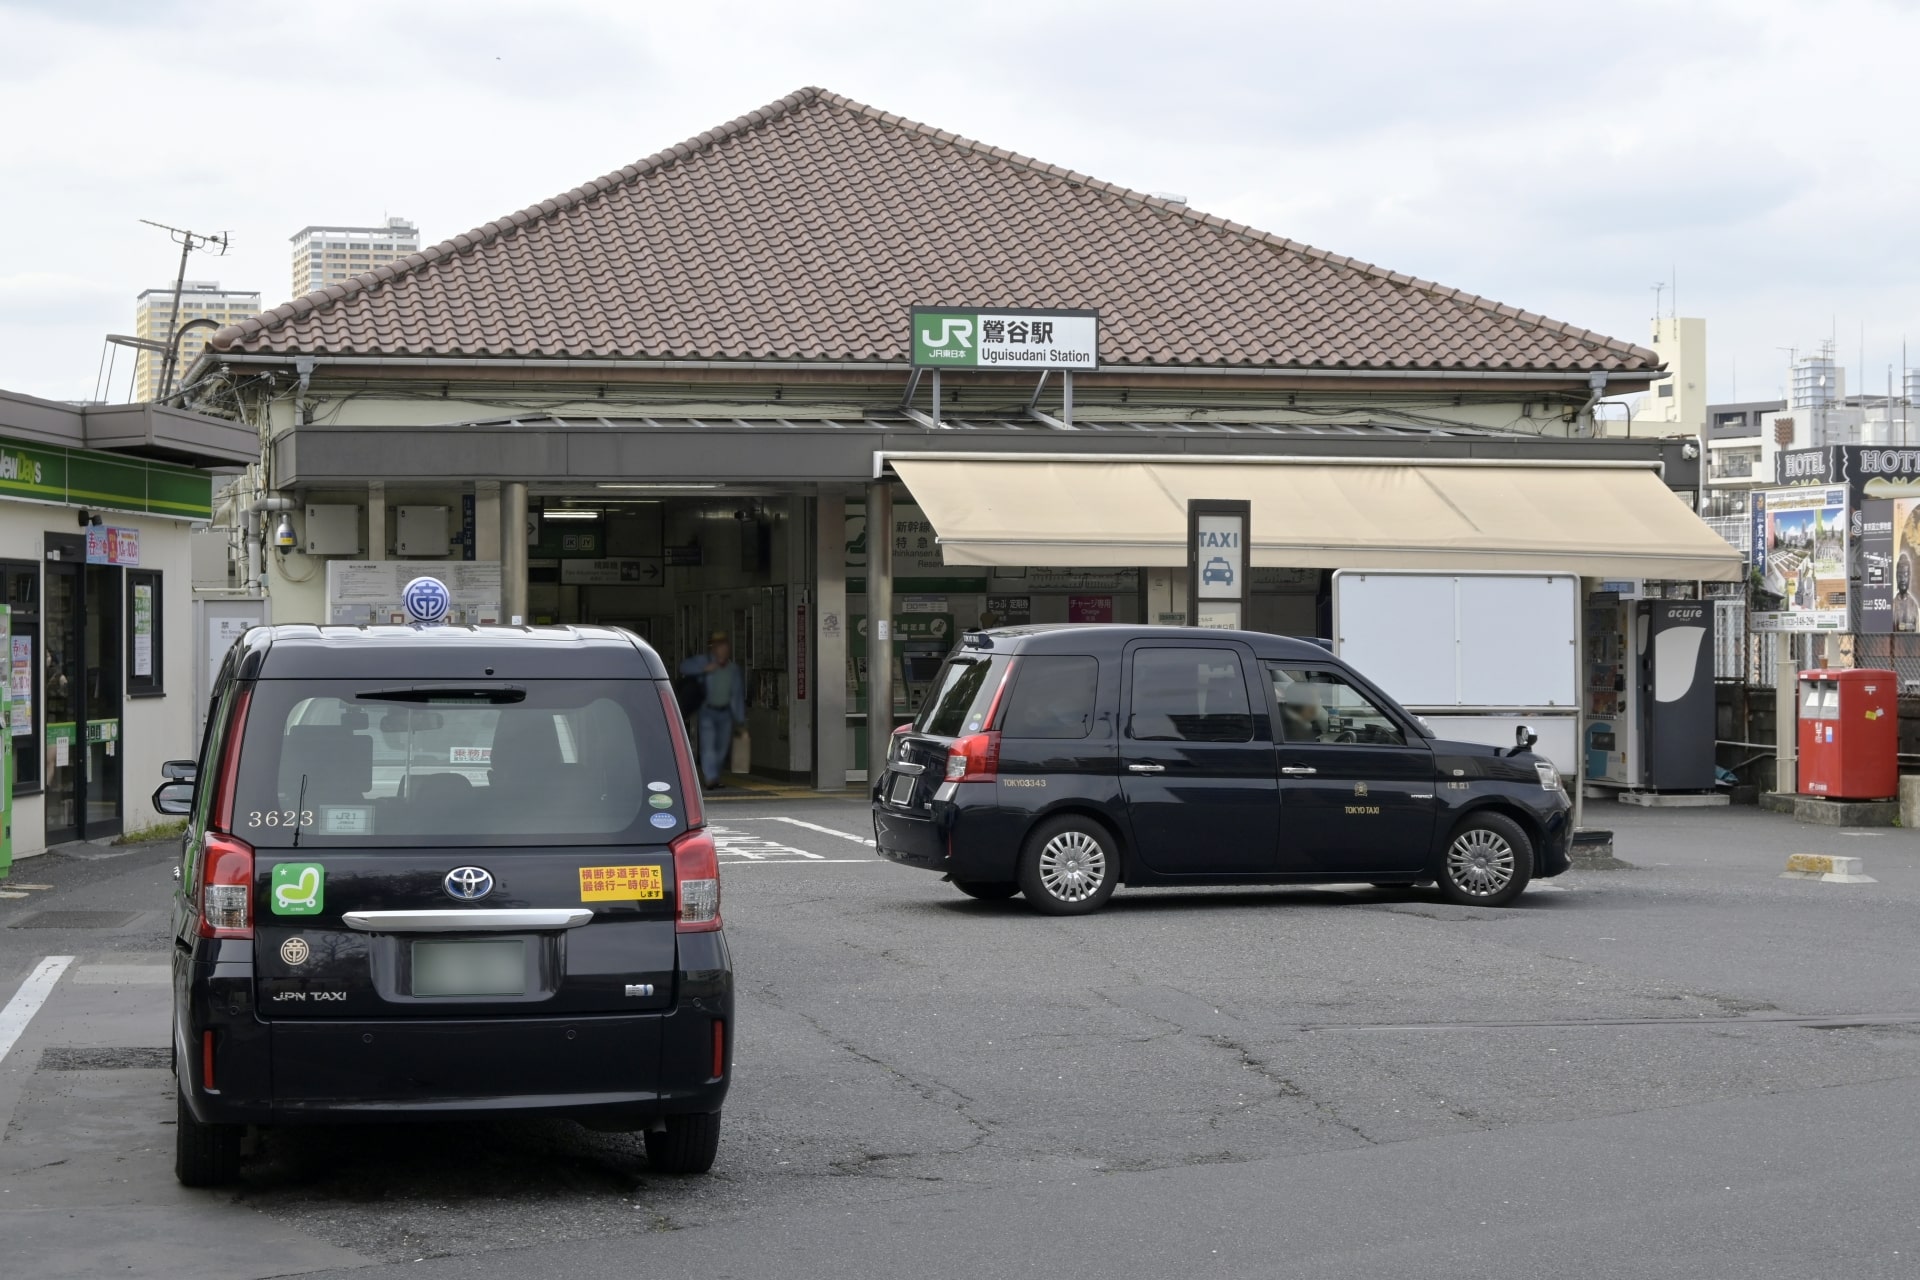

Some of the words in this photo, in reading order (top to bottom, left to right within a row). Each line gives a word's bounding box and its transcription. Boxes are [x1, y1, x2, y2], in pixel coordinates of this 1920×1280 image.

[922, 319, 973, 348] JR
[982, 320, 1053, 344] 鶯谷駅
[929, 350, 966, 358] JR東日本
[982, 348, 1046, 363] Uguisudani
[1050, 350, 1090, 363] Station
[1785, 452, 1826, 477] HOTEL
[895, 521, 930, 533] 新幹線
[566, 538, 576, 546] JK
[582, 538, 591, 546] JY
[1199, 532, 1239, 548] TAXI
[1668, 607, 1703, 618] acure
[1345, 806, 1365, 814] TOKYO
[1366, 806, 1379, 814] TAXI
[248, 810, 314, 827] 3623
[582, 867, 659, 880] 横断歩道手前で
[583, 878, 660, 892] 最徐行一時停止
[640, 890, 660, 898] します
[273, 992, 306, 1001] JPN
[310, 991, 347, 1001] TAXI
